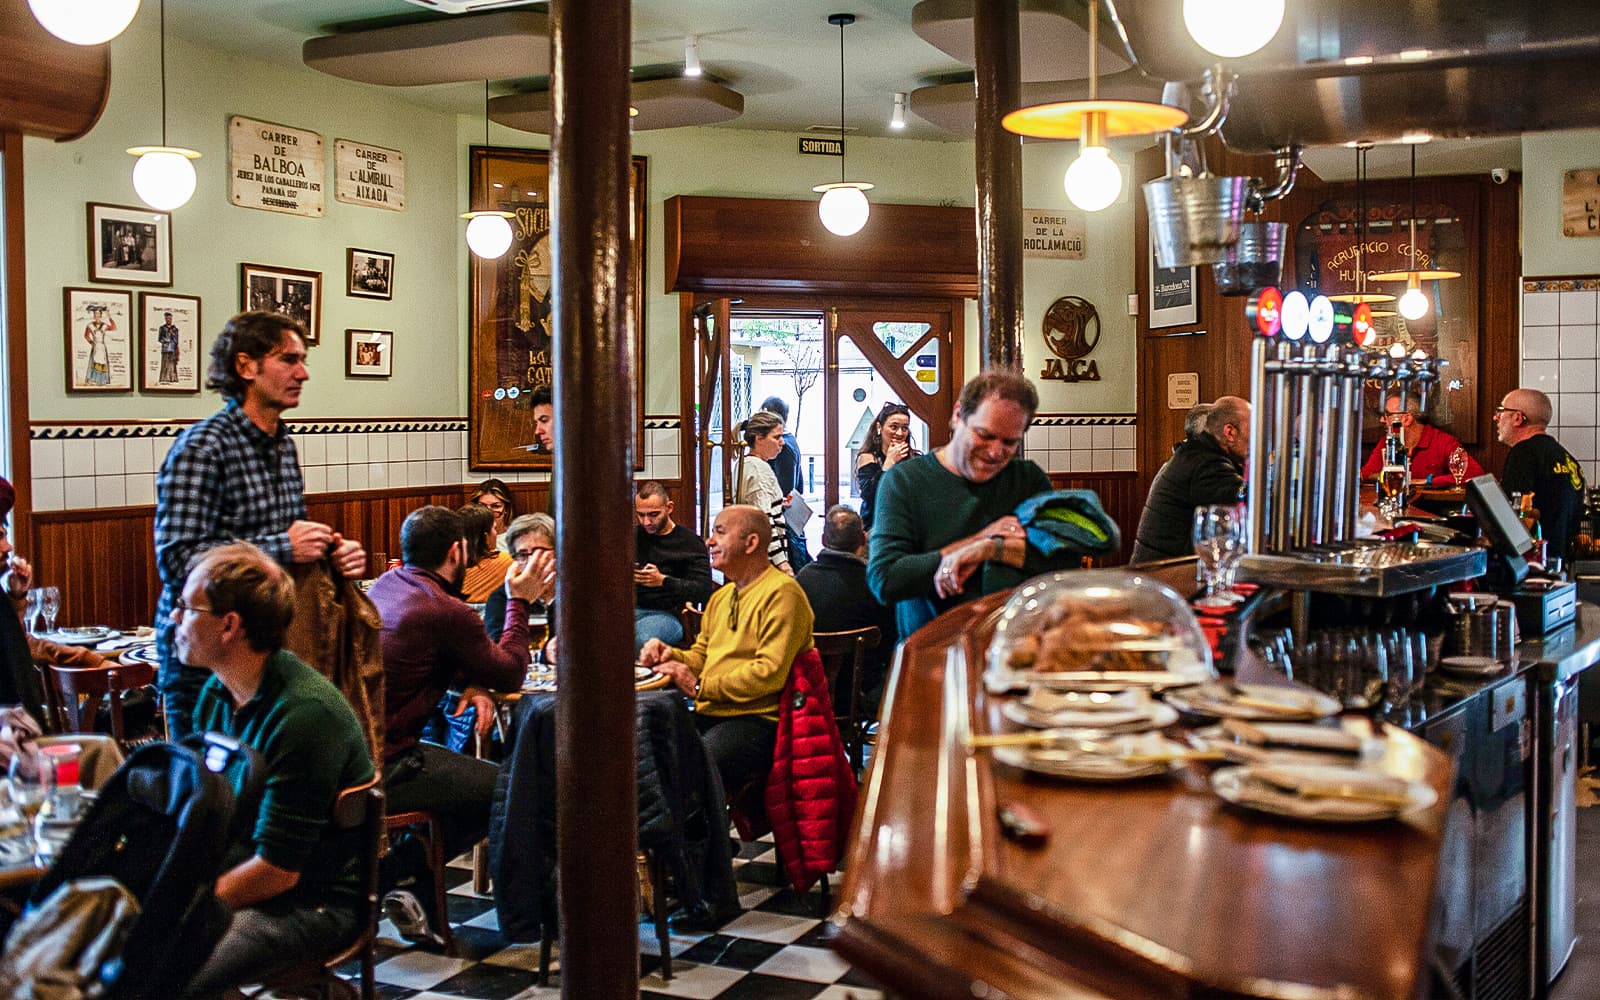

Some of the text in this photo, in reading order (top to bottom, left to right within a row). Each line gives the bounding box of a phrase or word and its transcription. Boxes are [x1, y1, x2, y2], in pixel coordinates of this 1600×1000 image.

[261, 130, 298, 146] CARRER
[274, 146, 287, 156] DE
[802, 140, 842, 154] SORTIDA
[355, 149, 388, 163] CARRER
[254, 154, 306, 178] BALBOA
[367, 161, 377, 170] DE
[237, 170, 254, 180] JEREZ
[256, 173, 263, 182] DE
[264, 175, 274, 184] LOS
[275, 177, 308, 190] CABALLEROS
[350, 169, 394, 188] L'ALMIRALL
[356, 185, 388, 202] AIXADA
[1032, 216, 1067, 225] CARRER
[1036, 228, 1064, 236] DE LA
[1023, 237, 1081, 252] ROCLAMACIÓ
[529, 350, 546, 365] LA
